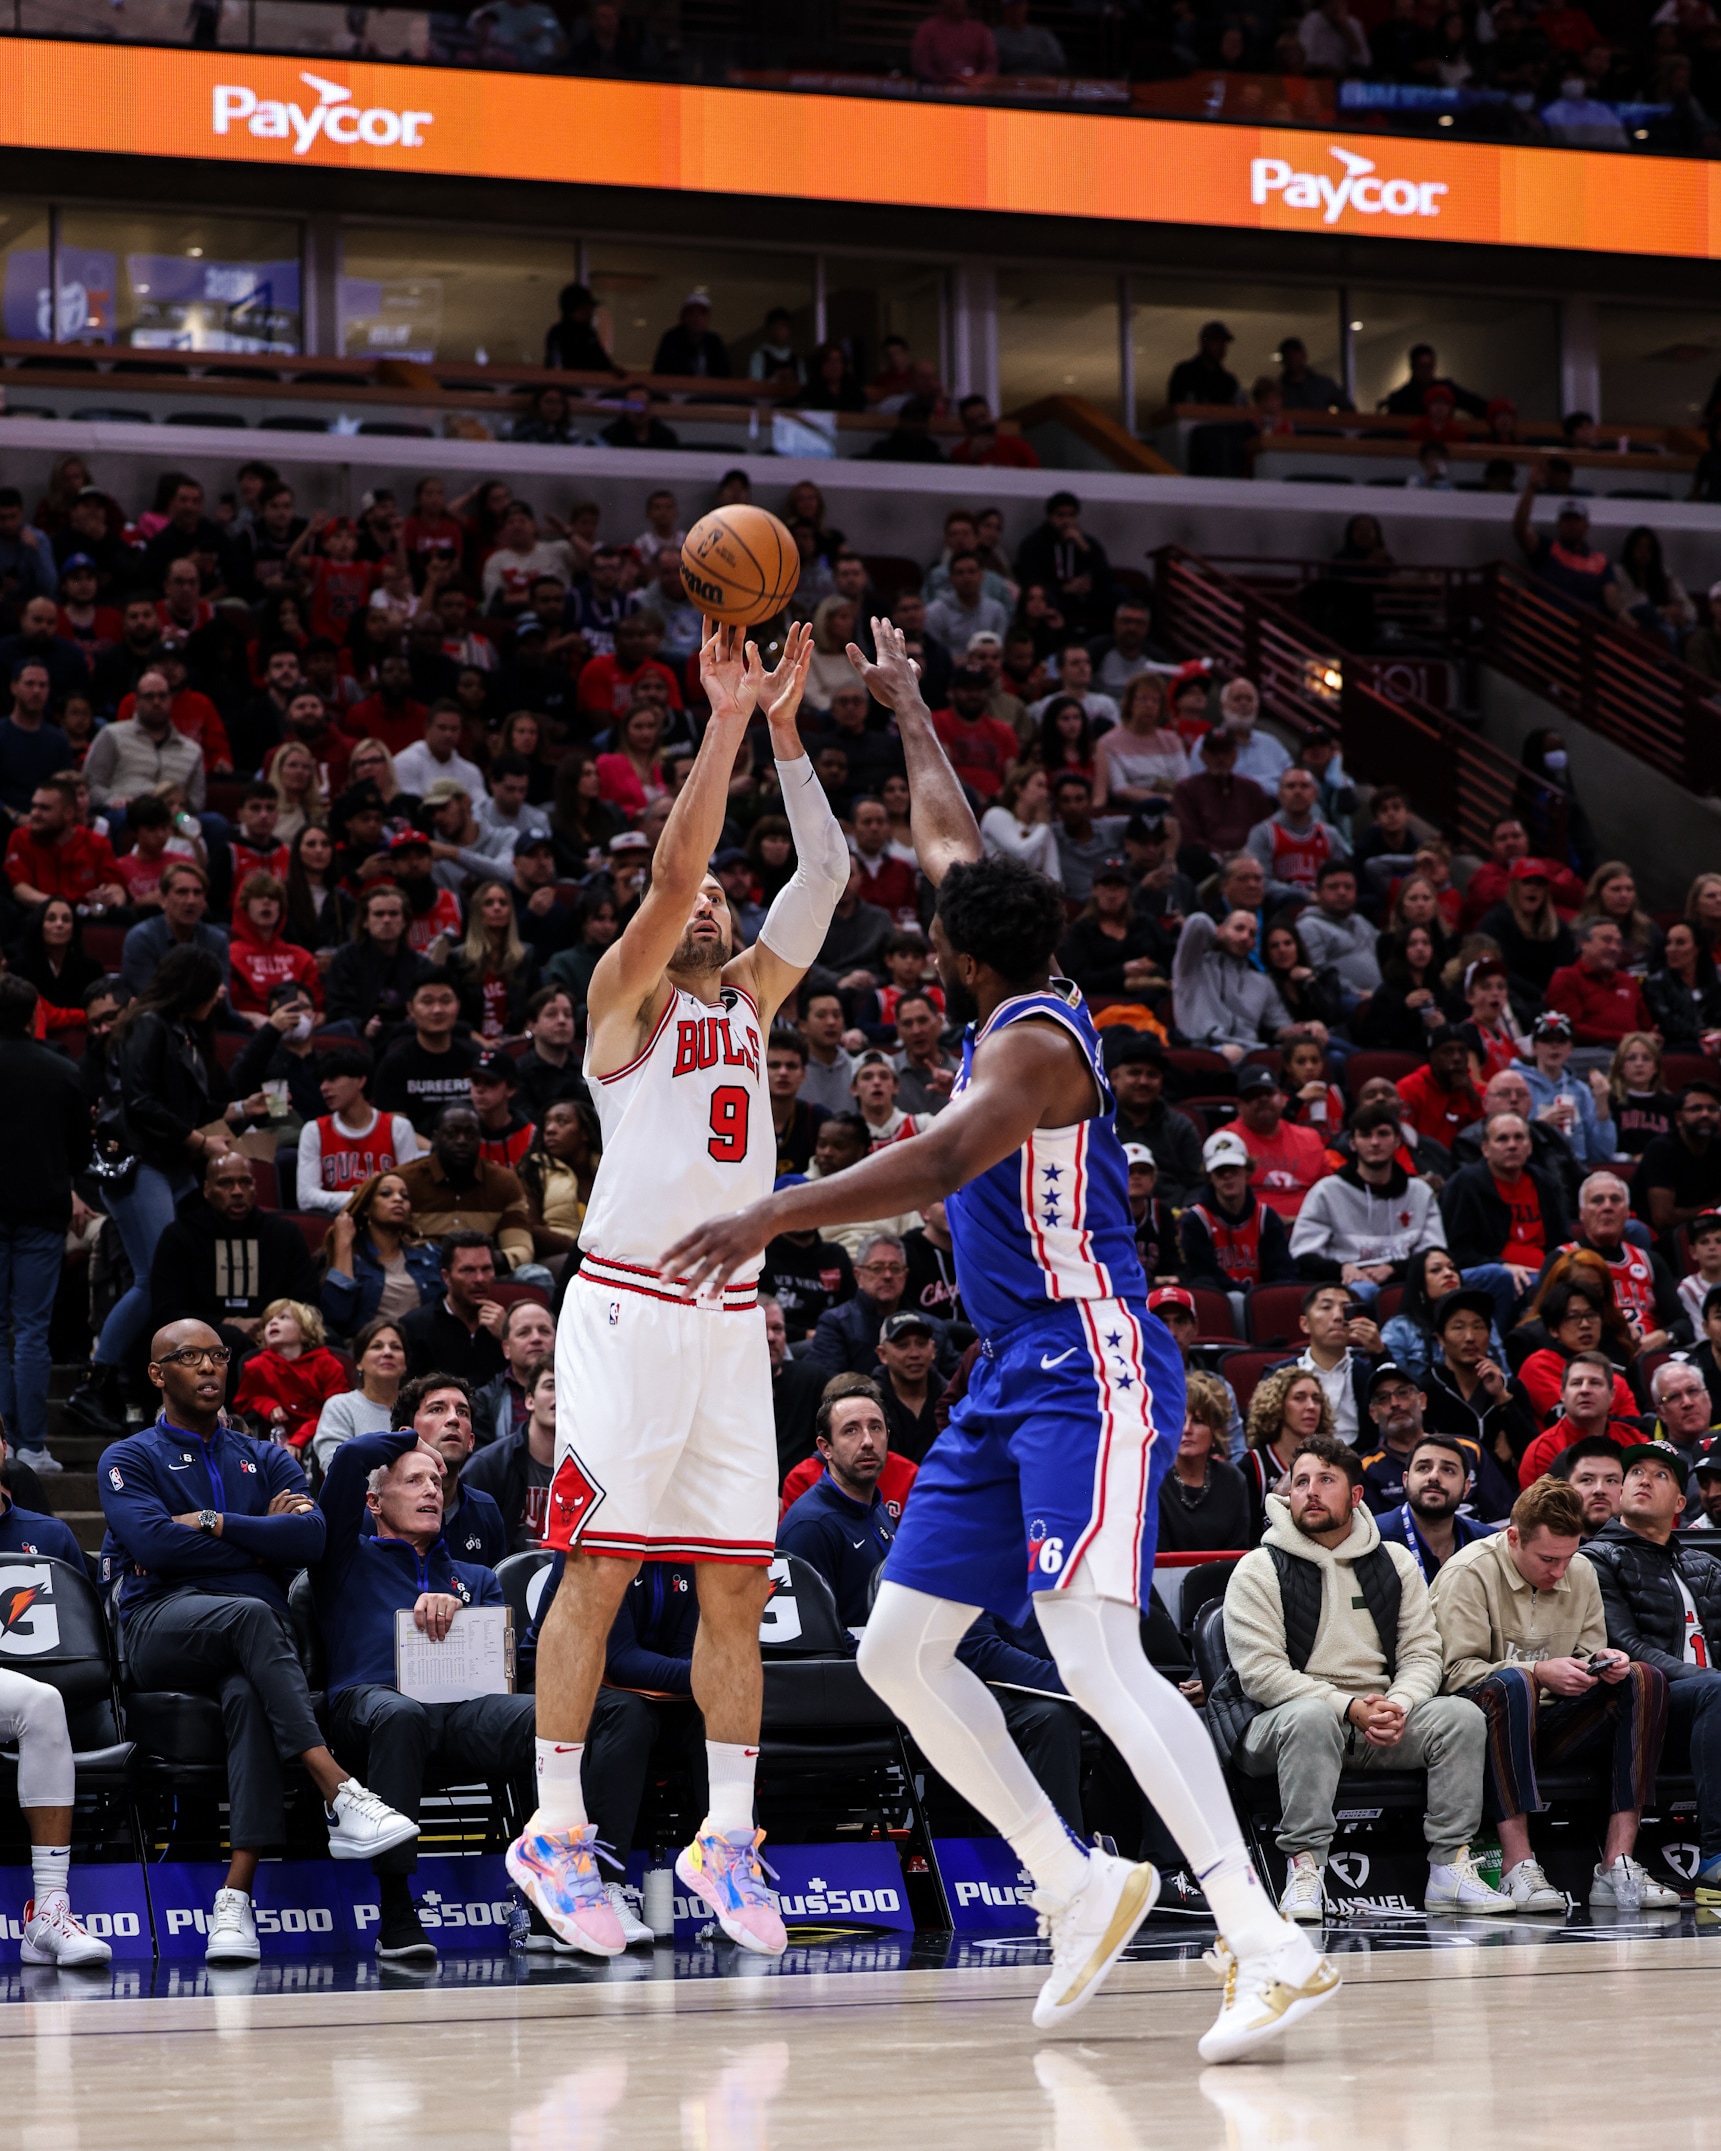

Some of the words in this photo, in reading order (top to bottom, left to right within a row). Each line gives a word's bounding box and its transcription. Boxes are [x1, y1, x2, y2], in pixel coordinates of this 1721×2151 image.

[213, 80, 434, 155] Paycor
[1251, 154, 1449, 224] Paycor
[407, 1077, 472, 1095] BURBERR
[708, 1085, 750, 1163] 9
[1028, 1535, 1064, 1574] 76
[672, 1580, 688, 1593] 76
[1471, 1849, 1502, 1859] OTHIN'
[353, 1901, 515, 1929] Ps500
[770, 1888, 900, 1915] lus500
[1327, 1895, 1415, 1915] ANDUEL
[0, 1912, 140, 1940] lu500
[166, 1908, 334, 1935] Pl500
